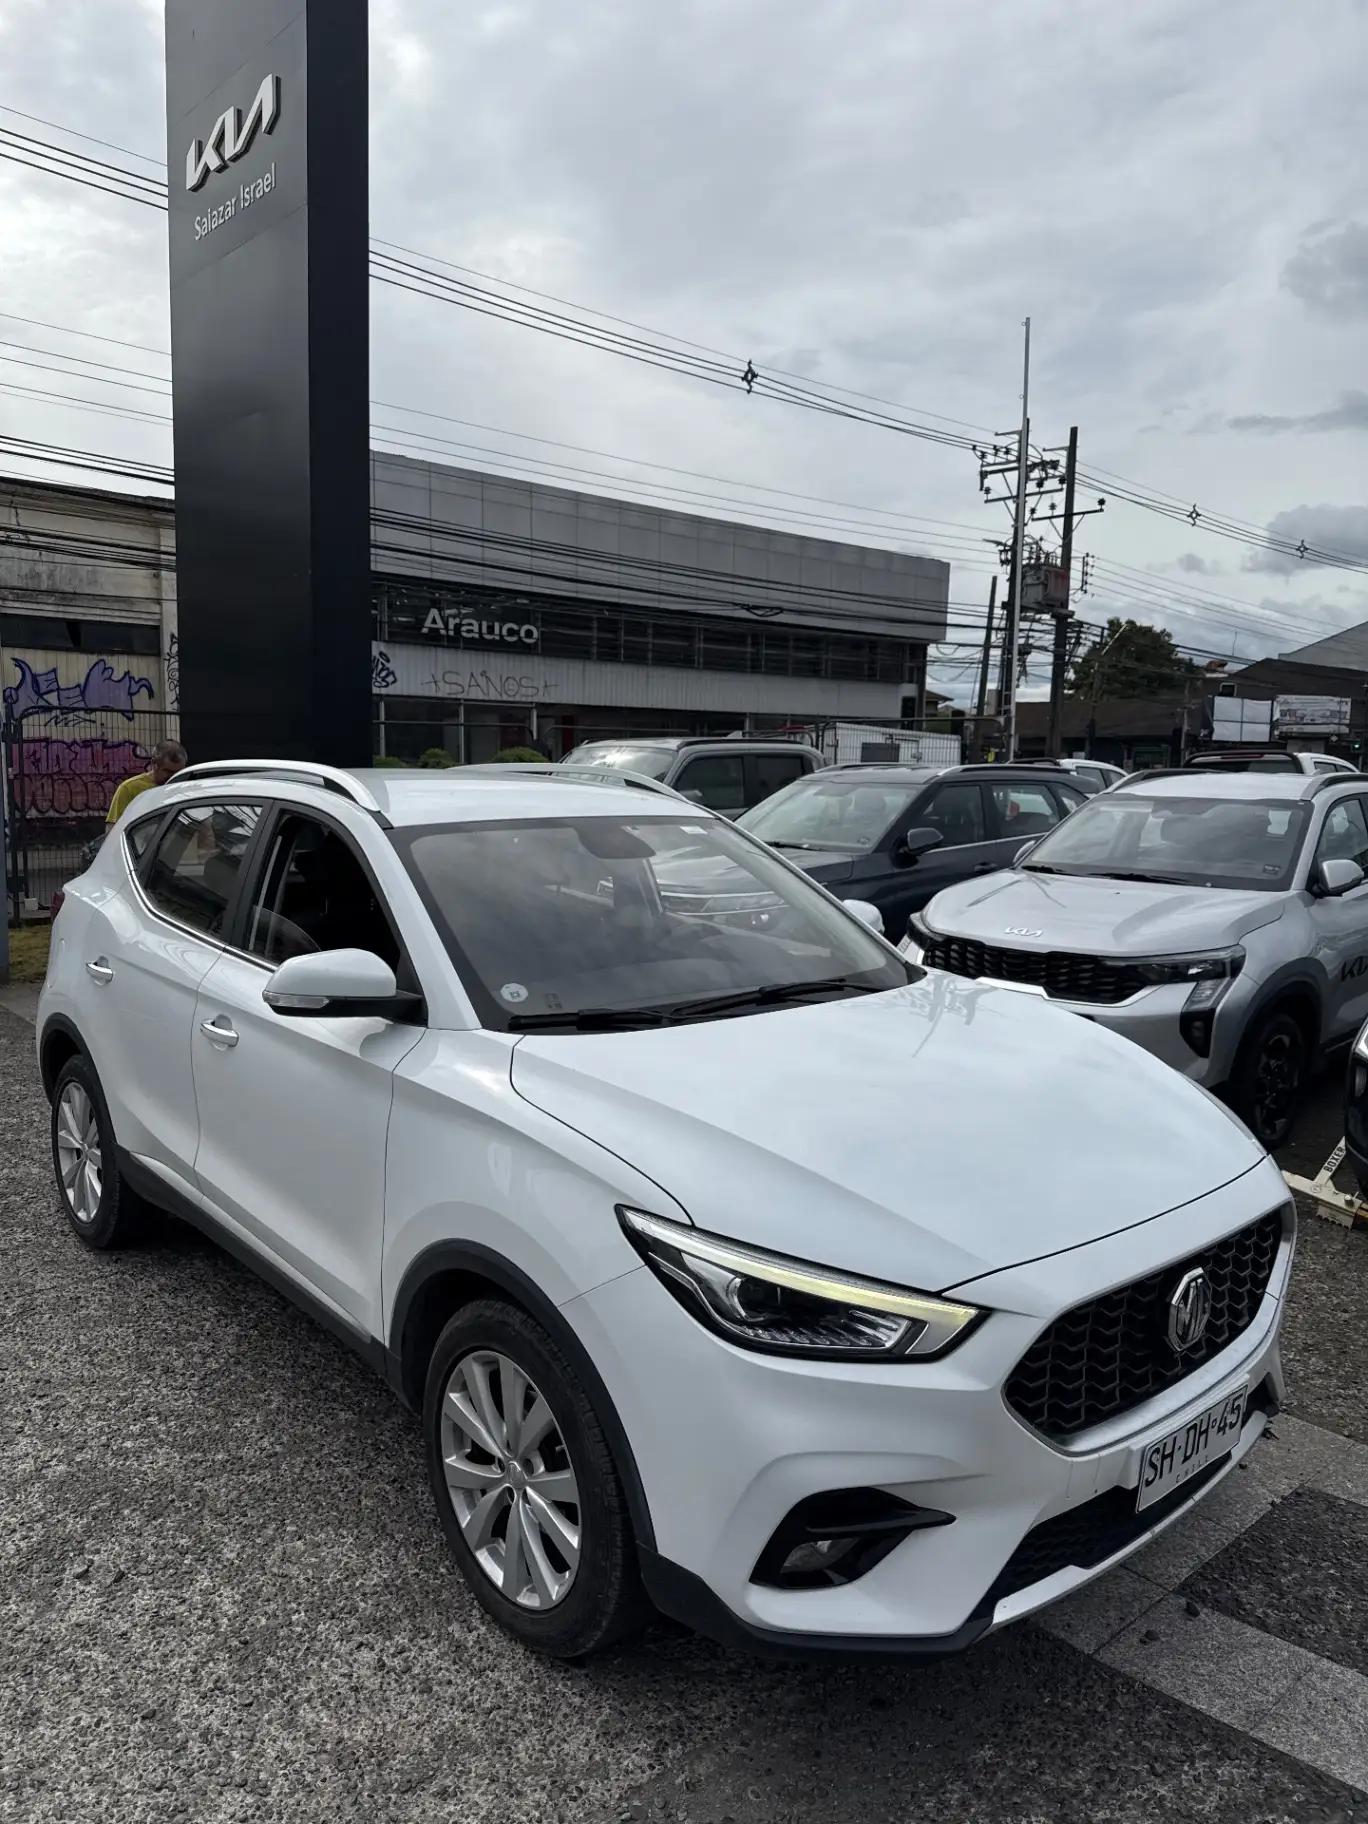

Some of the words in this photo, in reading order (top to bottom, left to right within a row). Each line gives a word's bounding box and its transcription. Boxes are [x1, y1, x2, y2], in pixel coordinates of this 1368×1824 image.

[186, 73, 278, 192] KIA
[195, 195, 237, 241] Salazar
[240, 162, 277, 210] Israel
[421, 607, 539, 644] Arauco
[1004, 926, 1044, 937] KIA
[1323, 1146, 1346, 1173] BOXER
